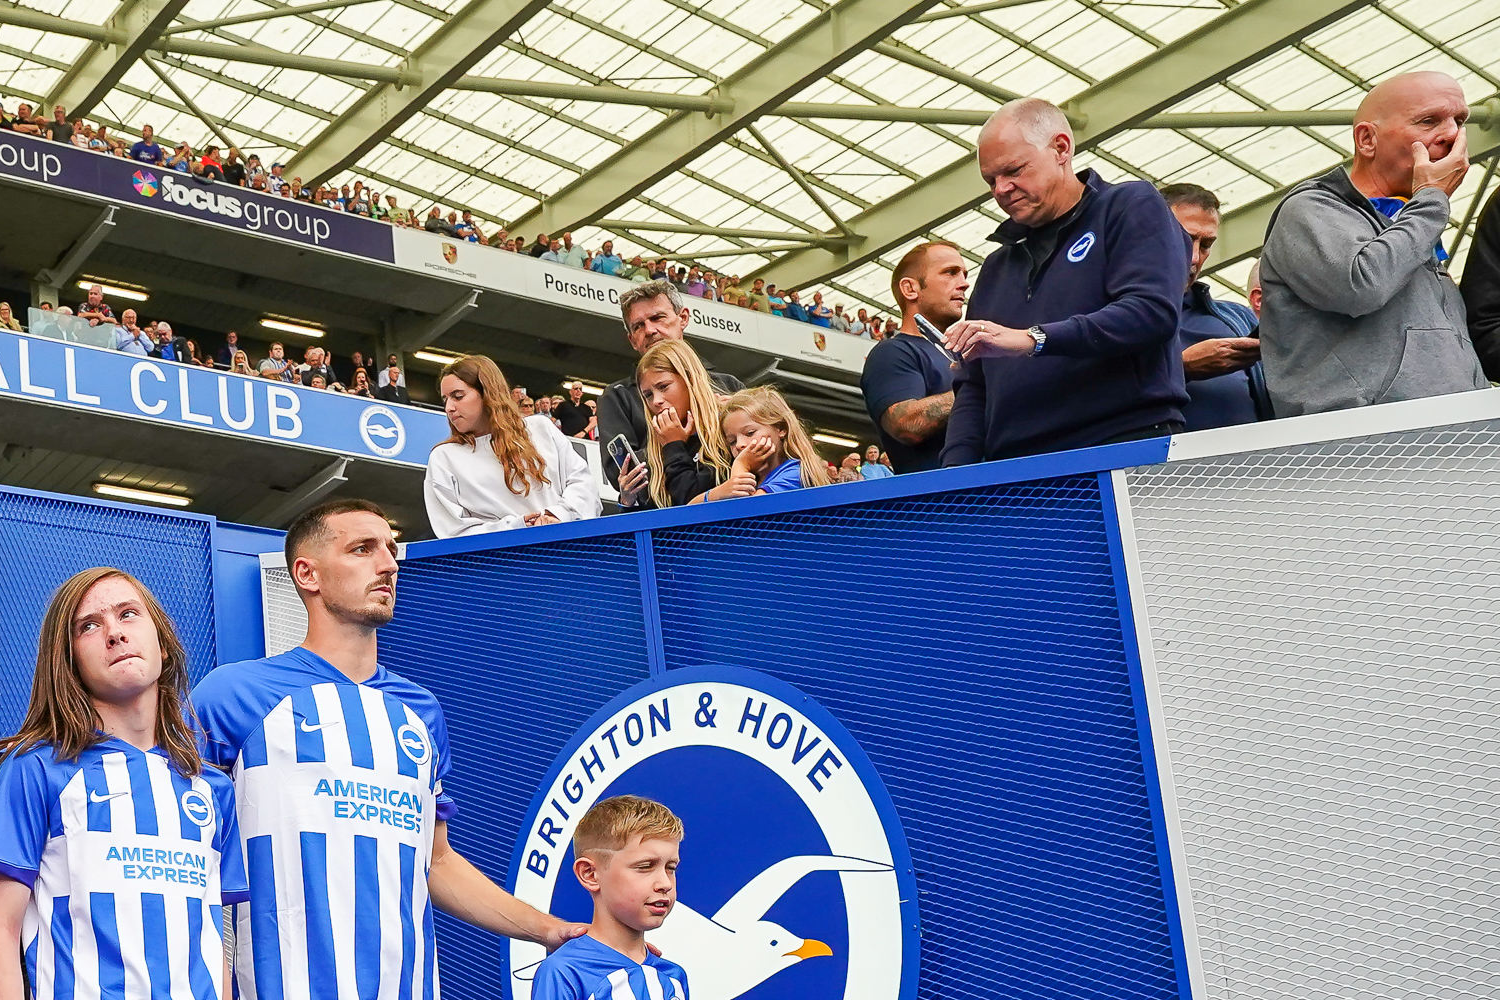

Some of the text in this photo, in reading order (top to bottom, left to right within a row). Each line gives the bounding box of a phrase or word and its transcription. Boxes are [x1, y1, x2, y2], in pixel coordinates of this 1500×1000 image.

[544, 273, 605, 302] Porsche
[130, 361, 302, 441] CLUB
[314, 778, 422, 814] AMERICAN
[526, 691, 843, 879] BRIGHTON & HOVE
[106, 846, 206, 870] AMERICAN
[123, 864, 207, 887] EXPRESS
